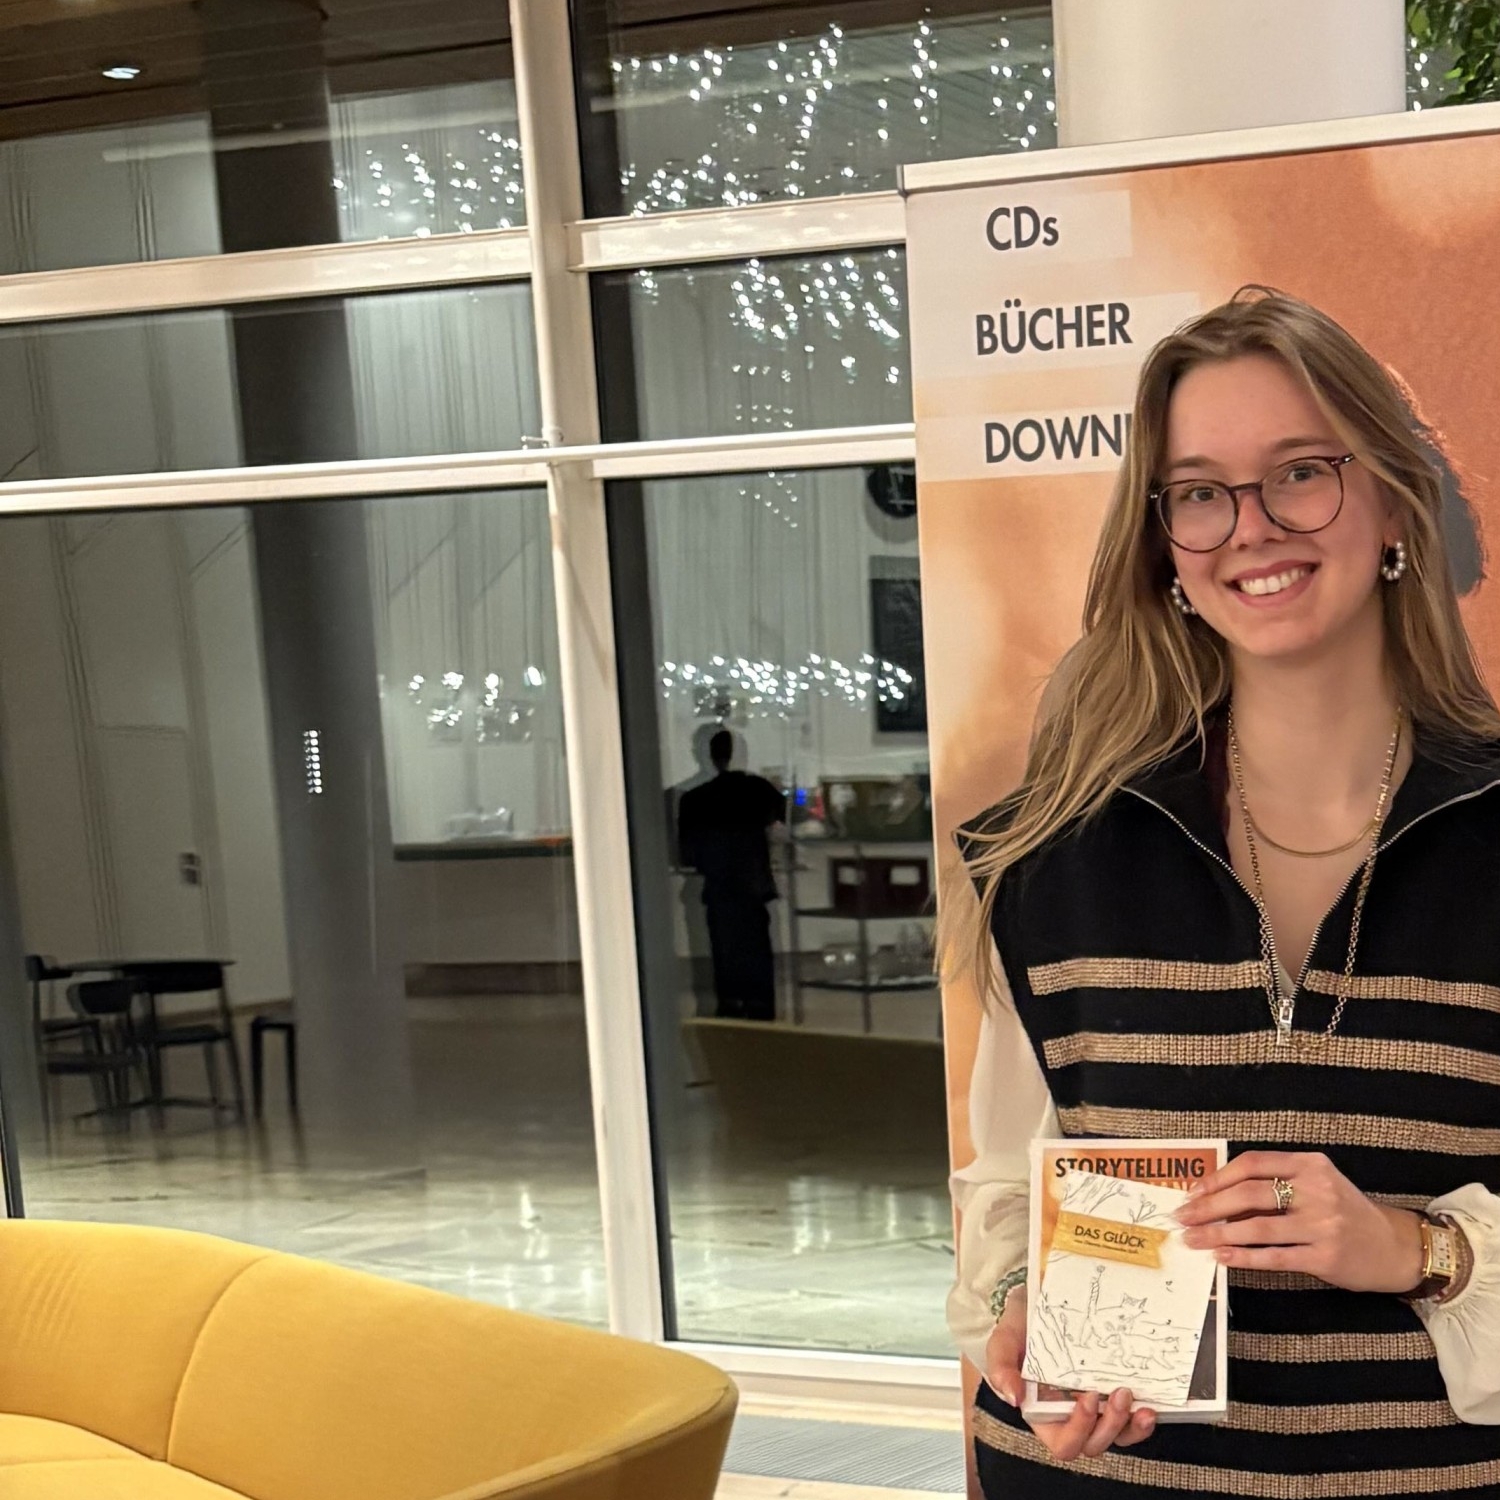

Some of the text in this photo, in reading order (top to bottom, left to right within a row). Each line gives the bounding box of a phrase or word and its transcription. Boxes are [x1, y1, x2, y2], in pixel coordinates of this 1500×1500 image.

[985, 205, 1060, 251] CDs
[975, 298, 1133, 356] BÜCHER
[1055, 1157, 1205, 1178] STORYTELLING
[1074, 1225, 1101, 1240] DAS
[1103, 1230, 1147, 1249] GLÜCK
